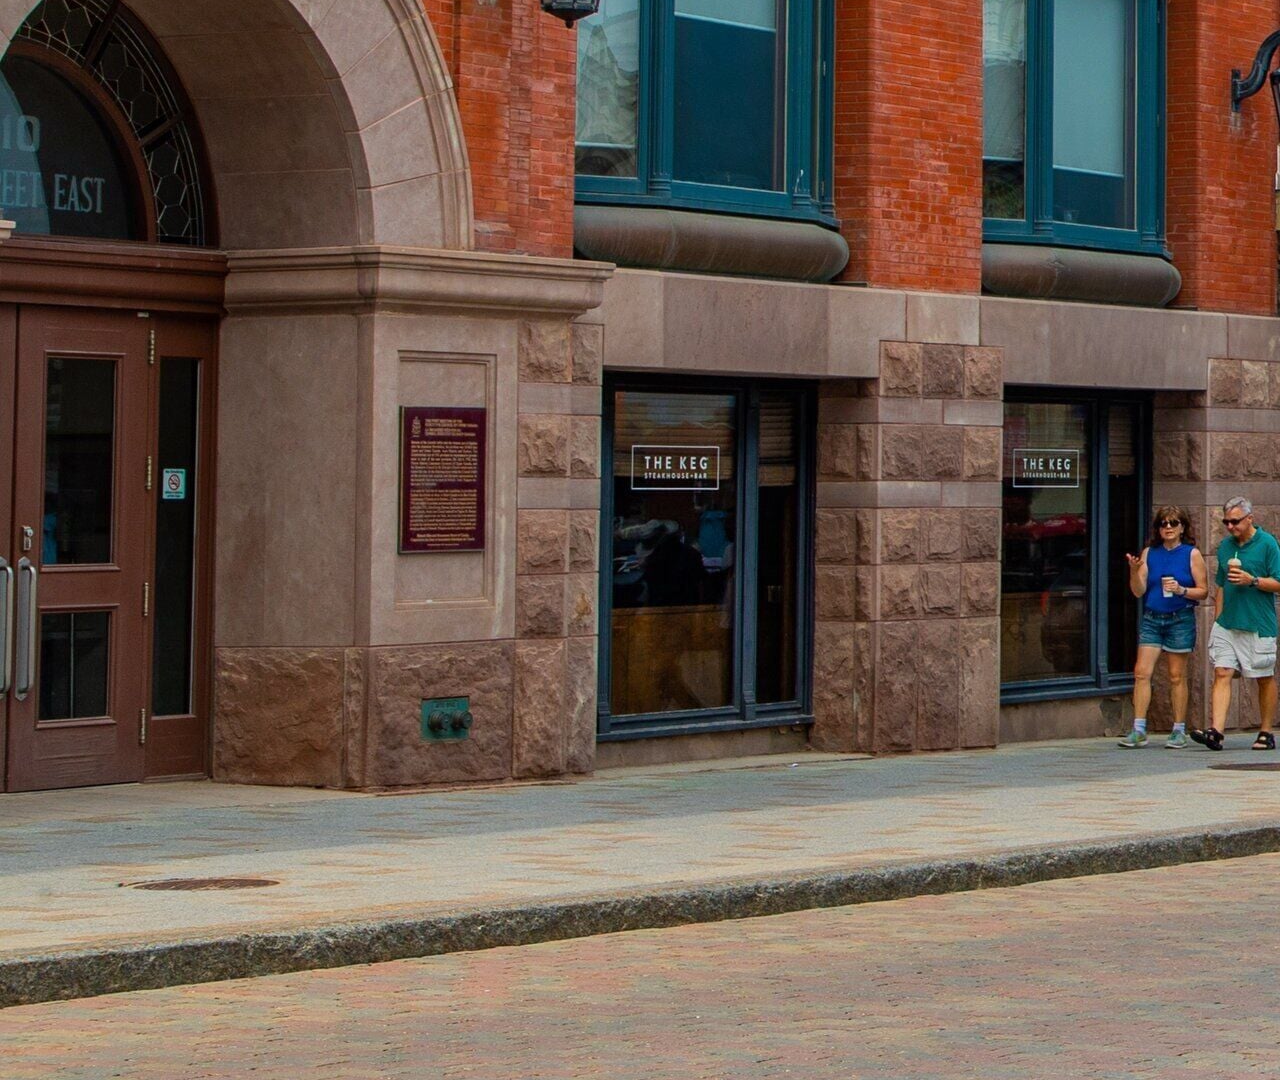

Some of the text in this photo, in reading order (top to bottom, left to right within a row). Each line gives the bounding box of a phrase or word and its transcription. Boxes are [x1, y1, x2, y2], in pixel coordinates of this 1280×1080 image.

[54, 173, 105, 214] EAST
[644, 456, 708, 470] THE KEG
[1023, 458, 1071, 470] THE KEG
